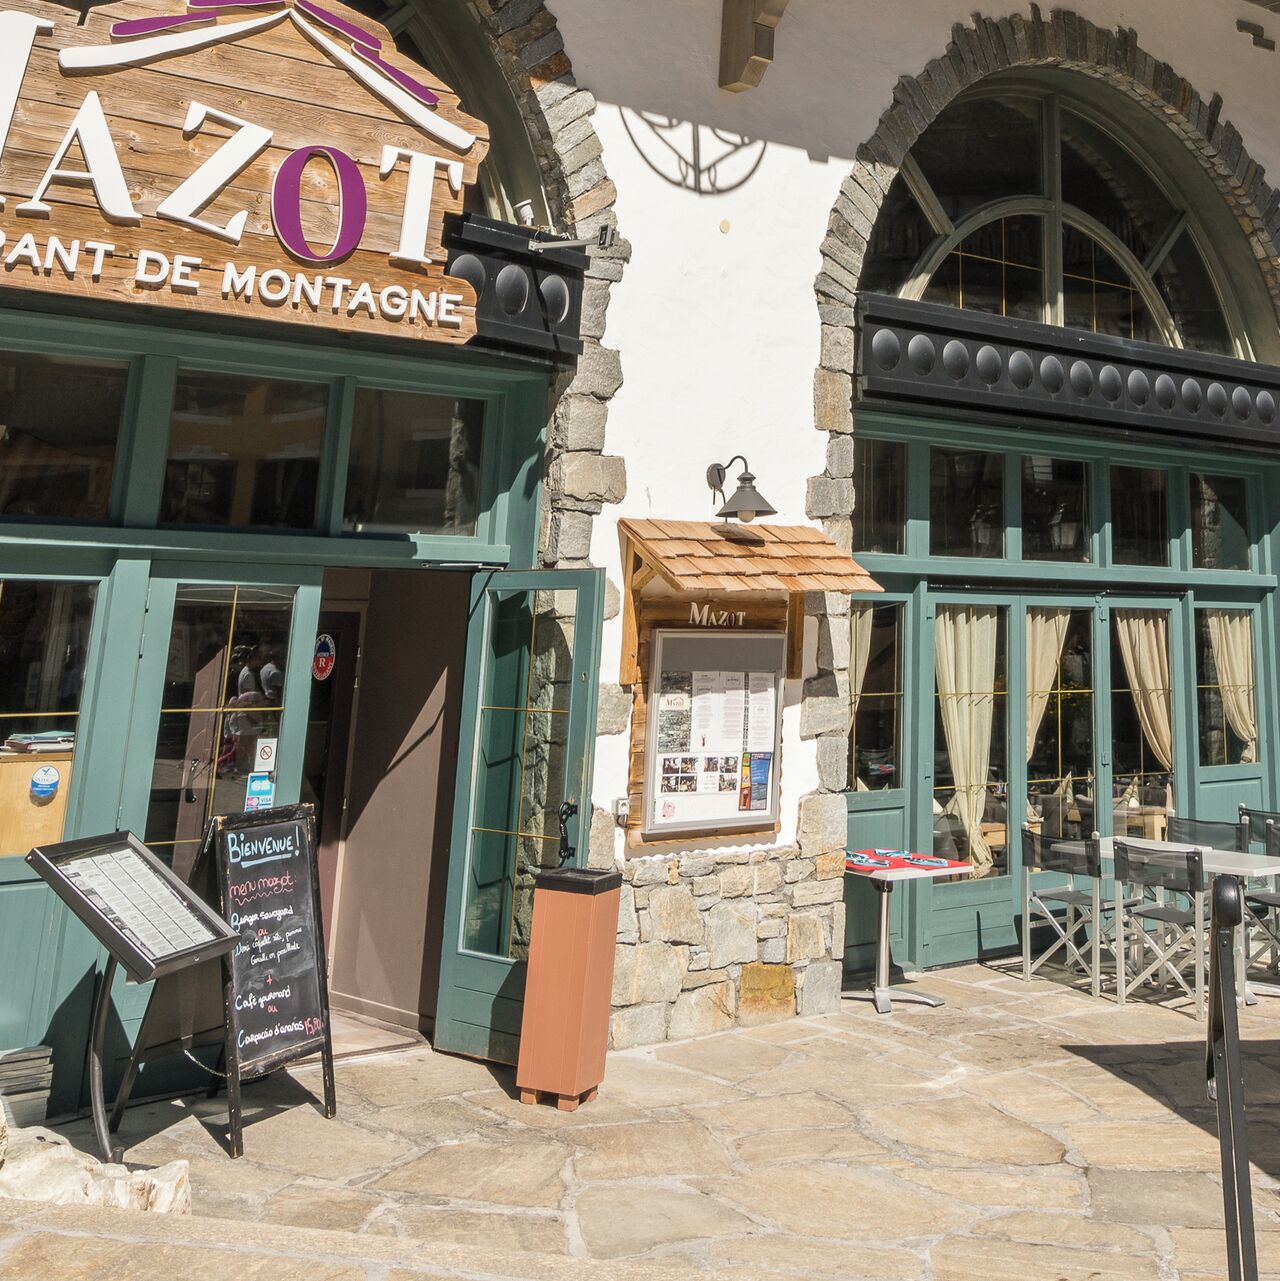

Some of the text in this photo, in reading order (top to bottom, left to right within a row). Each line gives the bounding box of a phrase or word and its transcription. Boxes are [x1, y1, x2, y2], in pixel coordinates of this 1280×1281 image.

[135, 249, 203, 289] DE
[222, 261, 464, 324] MONTAGNE
[687, 601, 746, 627] MAZOT
[230, 880, 255, 898] menu
[235, 986, 291, 1010] Café gourmand
